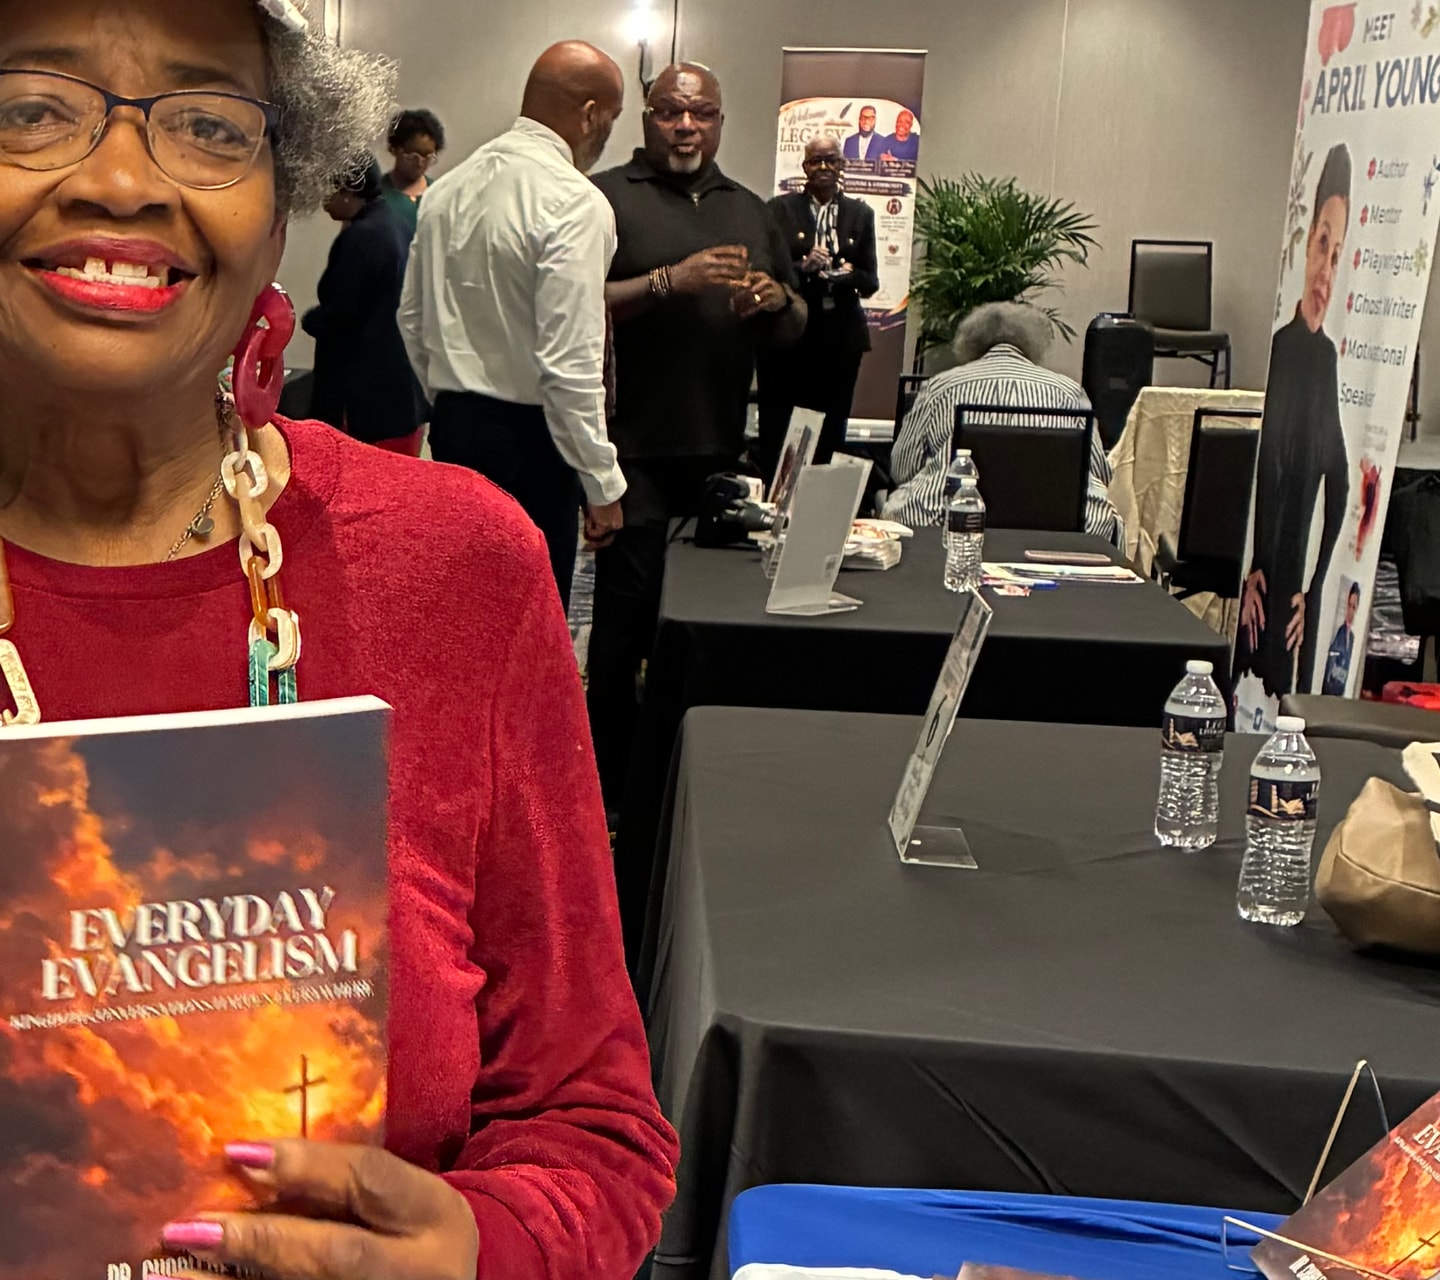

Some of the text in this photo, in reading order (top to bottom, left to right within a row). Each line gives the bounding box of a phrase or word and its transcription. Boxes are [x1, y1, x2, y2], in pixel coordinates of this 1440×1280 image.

[1362, 13, 1395, 43] MEET
[1310, 64, 1367, 116] APRIL
[1347, 338, 1407, 366] Motivational
[70, 885, 336, 951] EVERYDAY
[41, 929, 358, 1001] EVANGELISM
